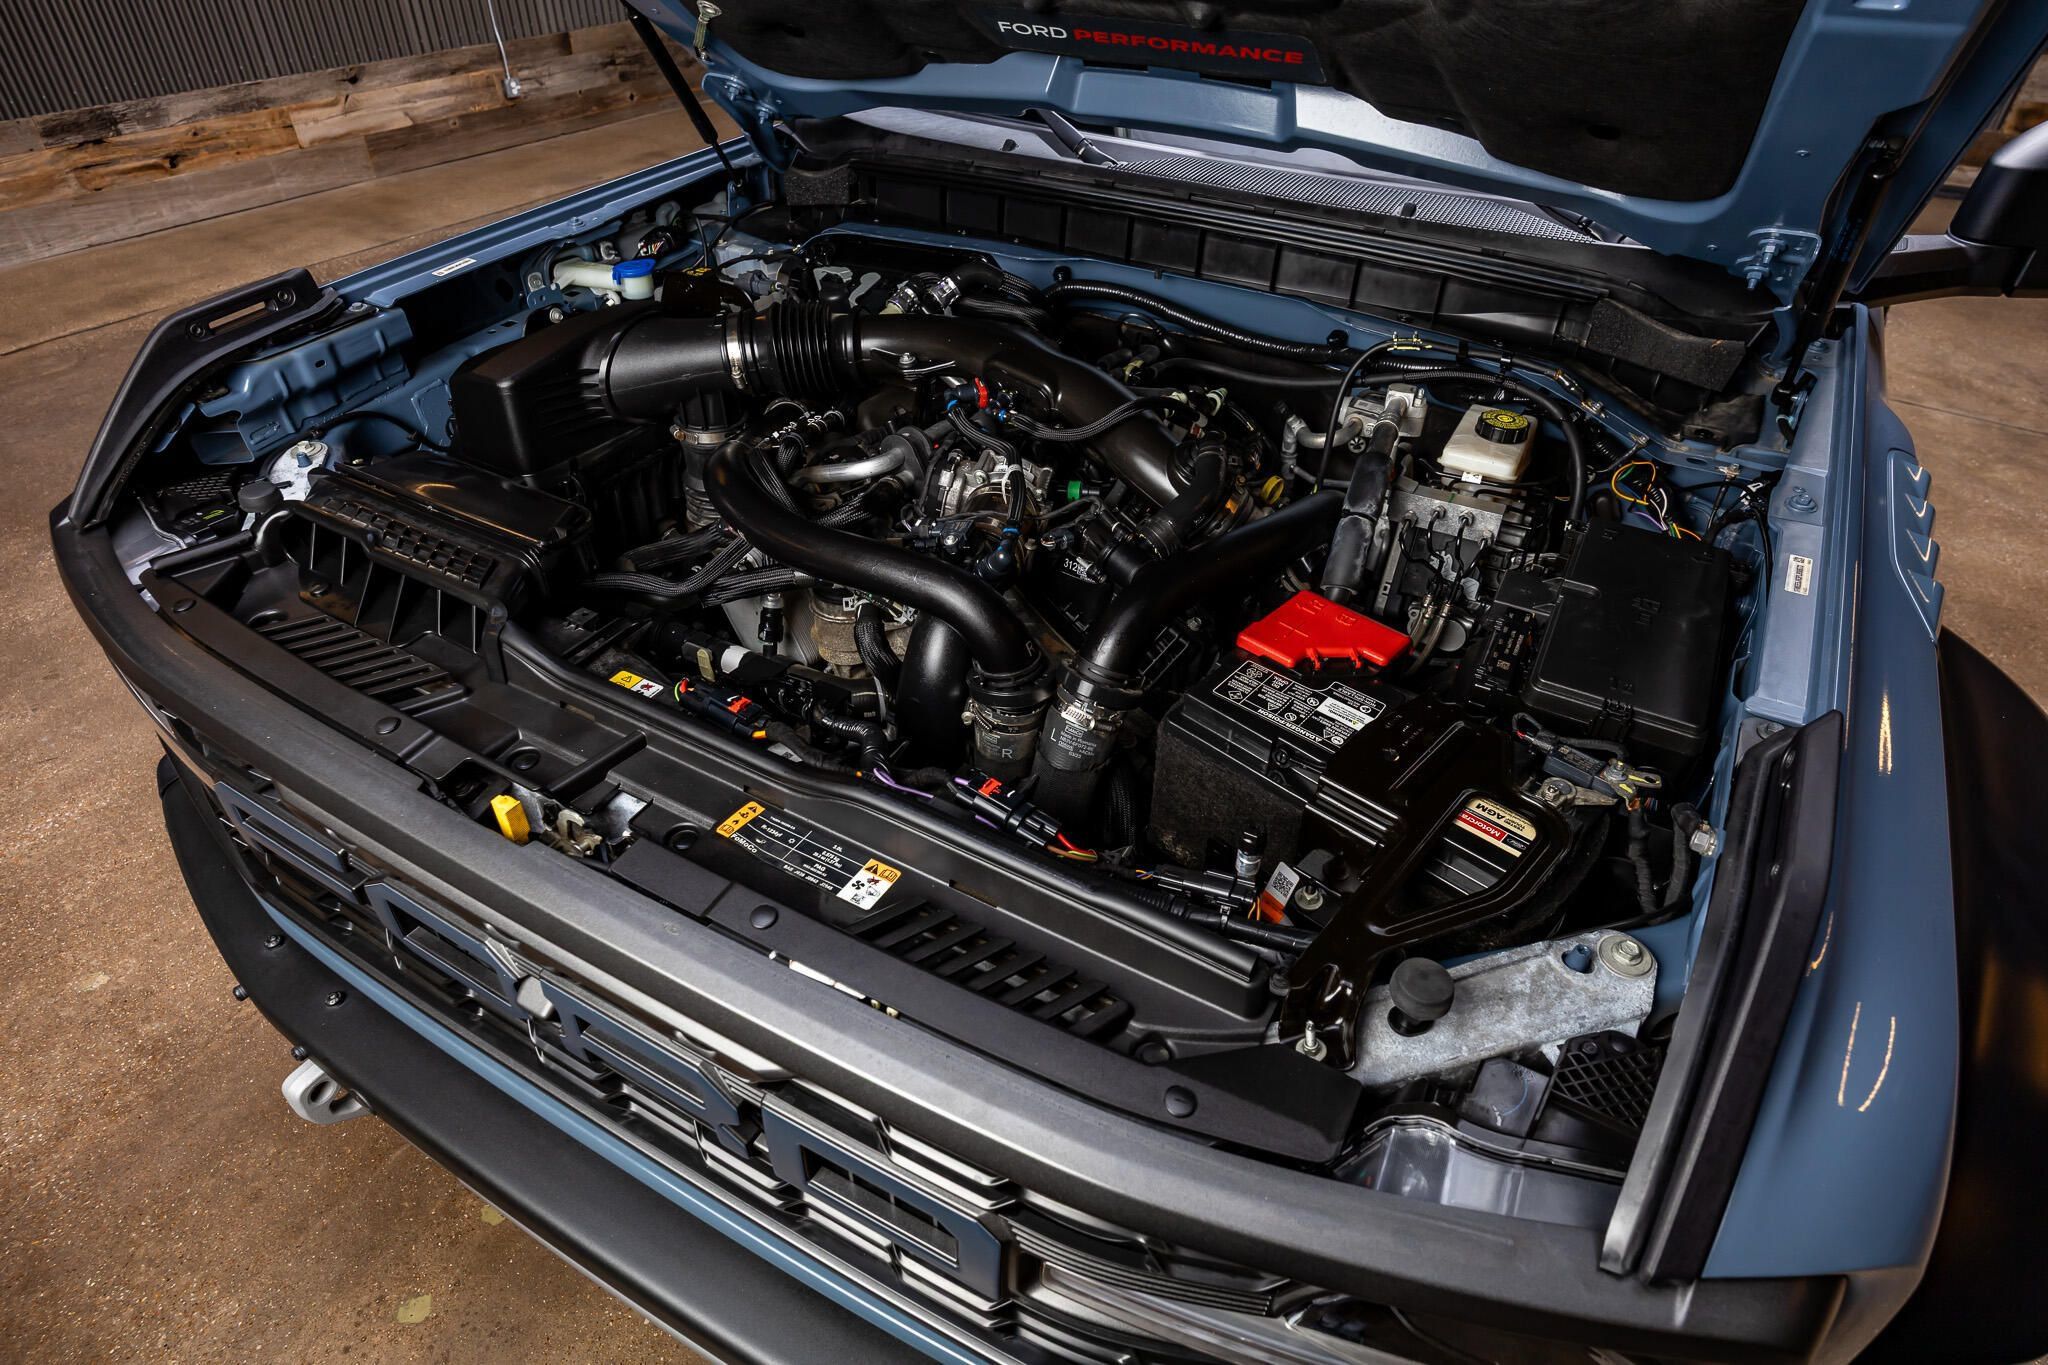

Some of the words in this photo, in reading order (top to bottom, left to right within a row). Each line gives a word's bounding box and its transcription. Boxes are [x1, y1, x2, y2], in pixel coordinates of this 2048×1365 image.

[998, 21, 1067, 39] FORD
[1073, 28, 1304, 65] PERFORMANCE
[1001, 748, 1013, 759] R
[1475, 803, 1505, 820] AGM
[1460, 813, 1501, 837] Motorcra
[730, 833, 758, 853] FoMoCo
